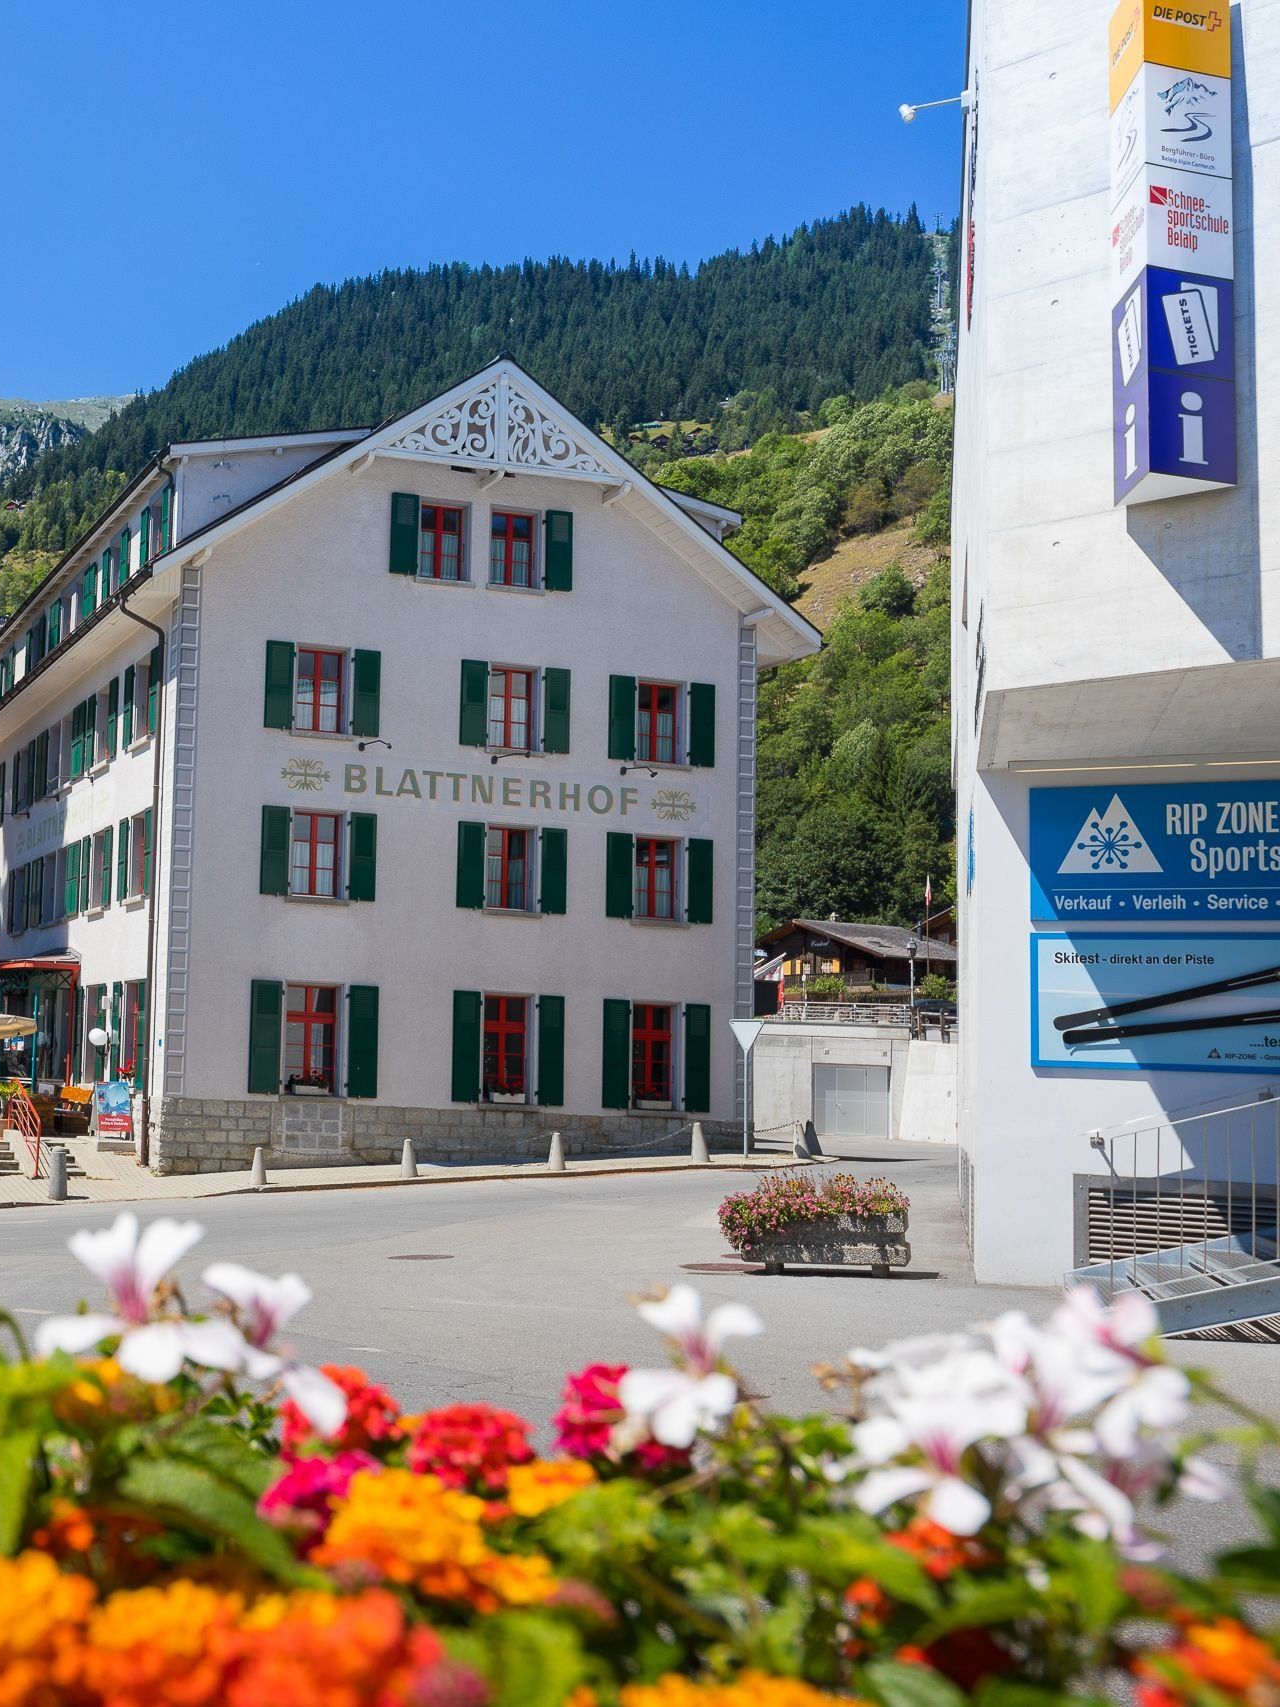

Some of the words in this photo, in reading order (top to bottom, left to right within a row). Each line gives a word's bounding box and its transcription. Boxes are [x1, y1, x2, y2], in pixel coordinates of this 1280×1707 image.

[1153, 5, 1173, 20] DIE
[1175, 10, 1207, 27] POST
[1161, 145, 1215, 162] Bergführer-Büro
[1167, 189, 1211, 211] Schnee-
[1167, 208, 1229, 234] sportschule
[1167, 227, 1198, 253] Belalp
[1179, 298, 1200, 359] TICKETS
[343, 763, 640, 816] BLATTNERHOF
[1166, 803, 1208, 835] RIP
[1216, 801, 1280, 834] ZONE
[1190, 838, 1280, 879] Sports
[1055, 895, 1112, 911] Verkauf
[1133, 895, 1186, 910] Verleih
[1207, 894, 1268, 910] Service
[1054, 952, 1100, 965] Skitest
[1110, 953, 1142, 965] direkt
[1145, 956, 1160, 965] an
[1163, 954, 1182, 965] der
[1185, 953, 1215, 965] Piste
